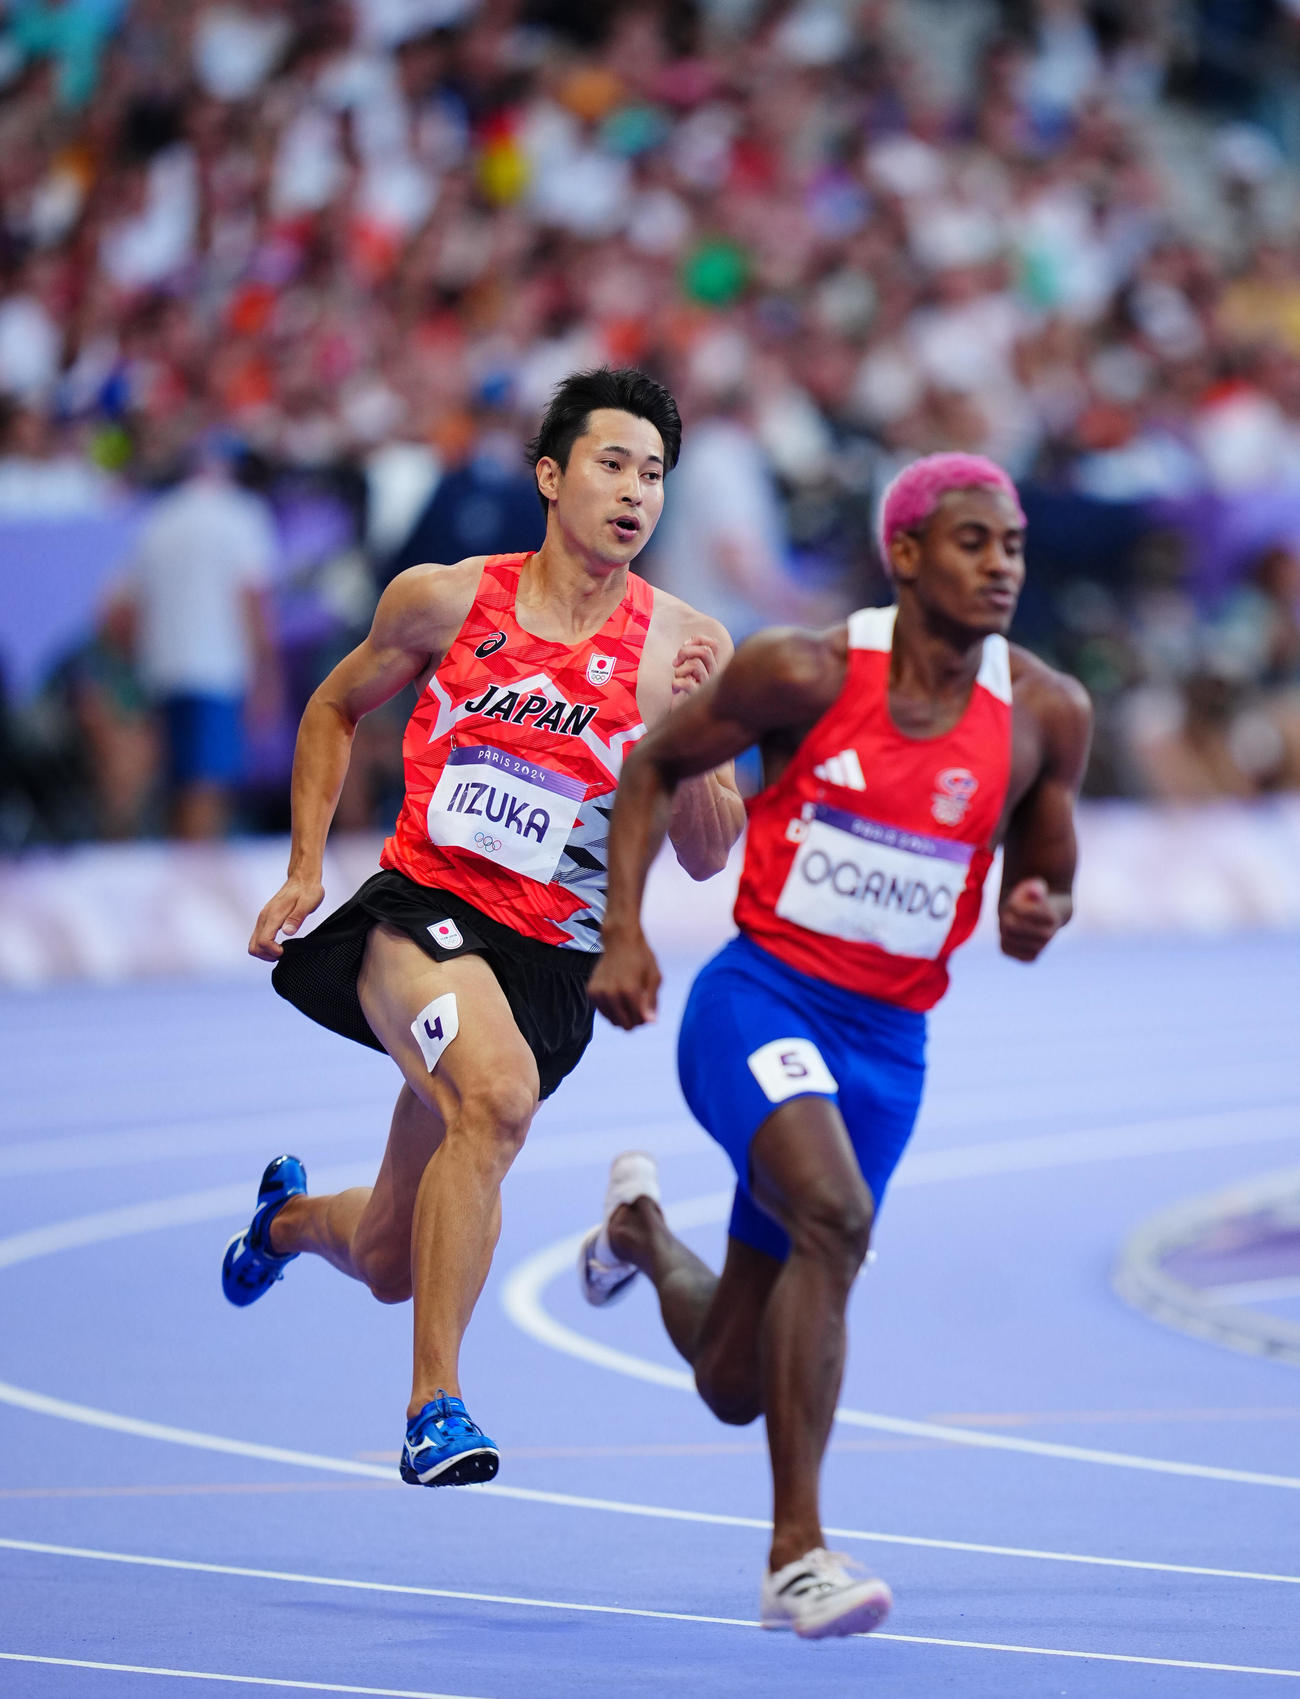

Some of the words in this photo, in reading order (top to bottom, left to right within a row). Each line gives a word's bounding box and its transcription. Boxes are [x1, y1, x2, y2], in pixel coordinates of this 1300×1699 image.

[464, 684, 599, 737] JAPAN
[478, 750, 511, 767] PARIS
[513, 762, 546, 782] 2024
[446, 782, 550, 843] IIZUKA
[801, 850, 953, 920] OGANDO
[423, 1016, 444, 1041] 4
[779, 1051, 808, 1078] 5
